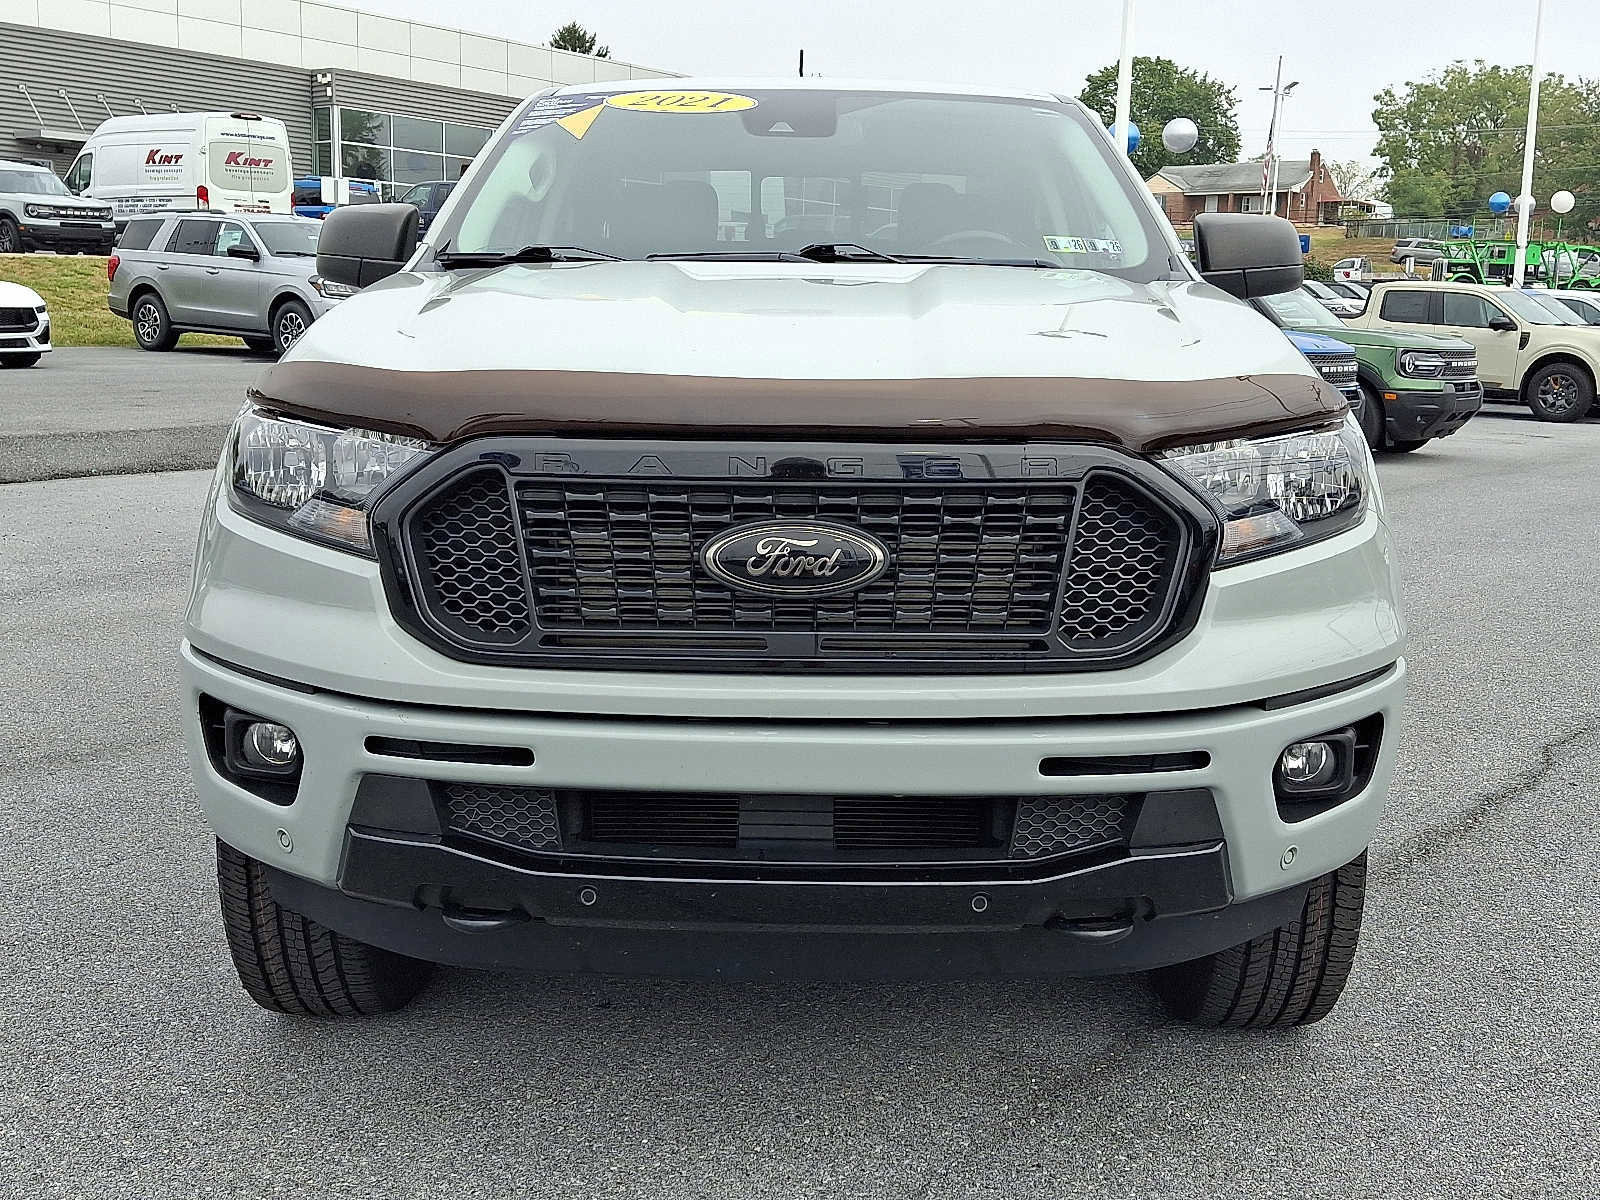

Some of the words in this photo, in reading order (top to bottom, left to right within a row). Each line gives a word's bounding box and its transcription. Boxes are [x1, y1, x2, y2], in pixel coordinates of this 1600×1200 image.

[627, 94, 735, 107] 2021
[145, 148, 184, 165] KINT
[224, 151, 274, 168] KINT
[534, 452, 1058, 478] RANGER
[746, 537, 842, 577] Ford
